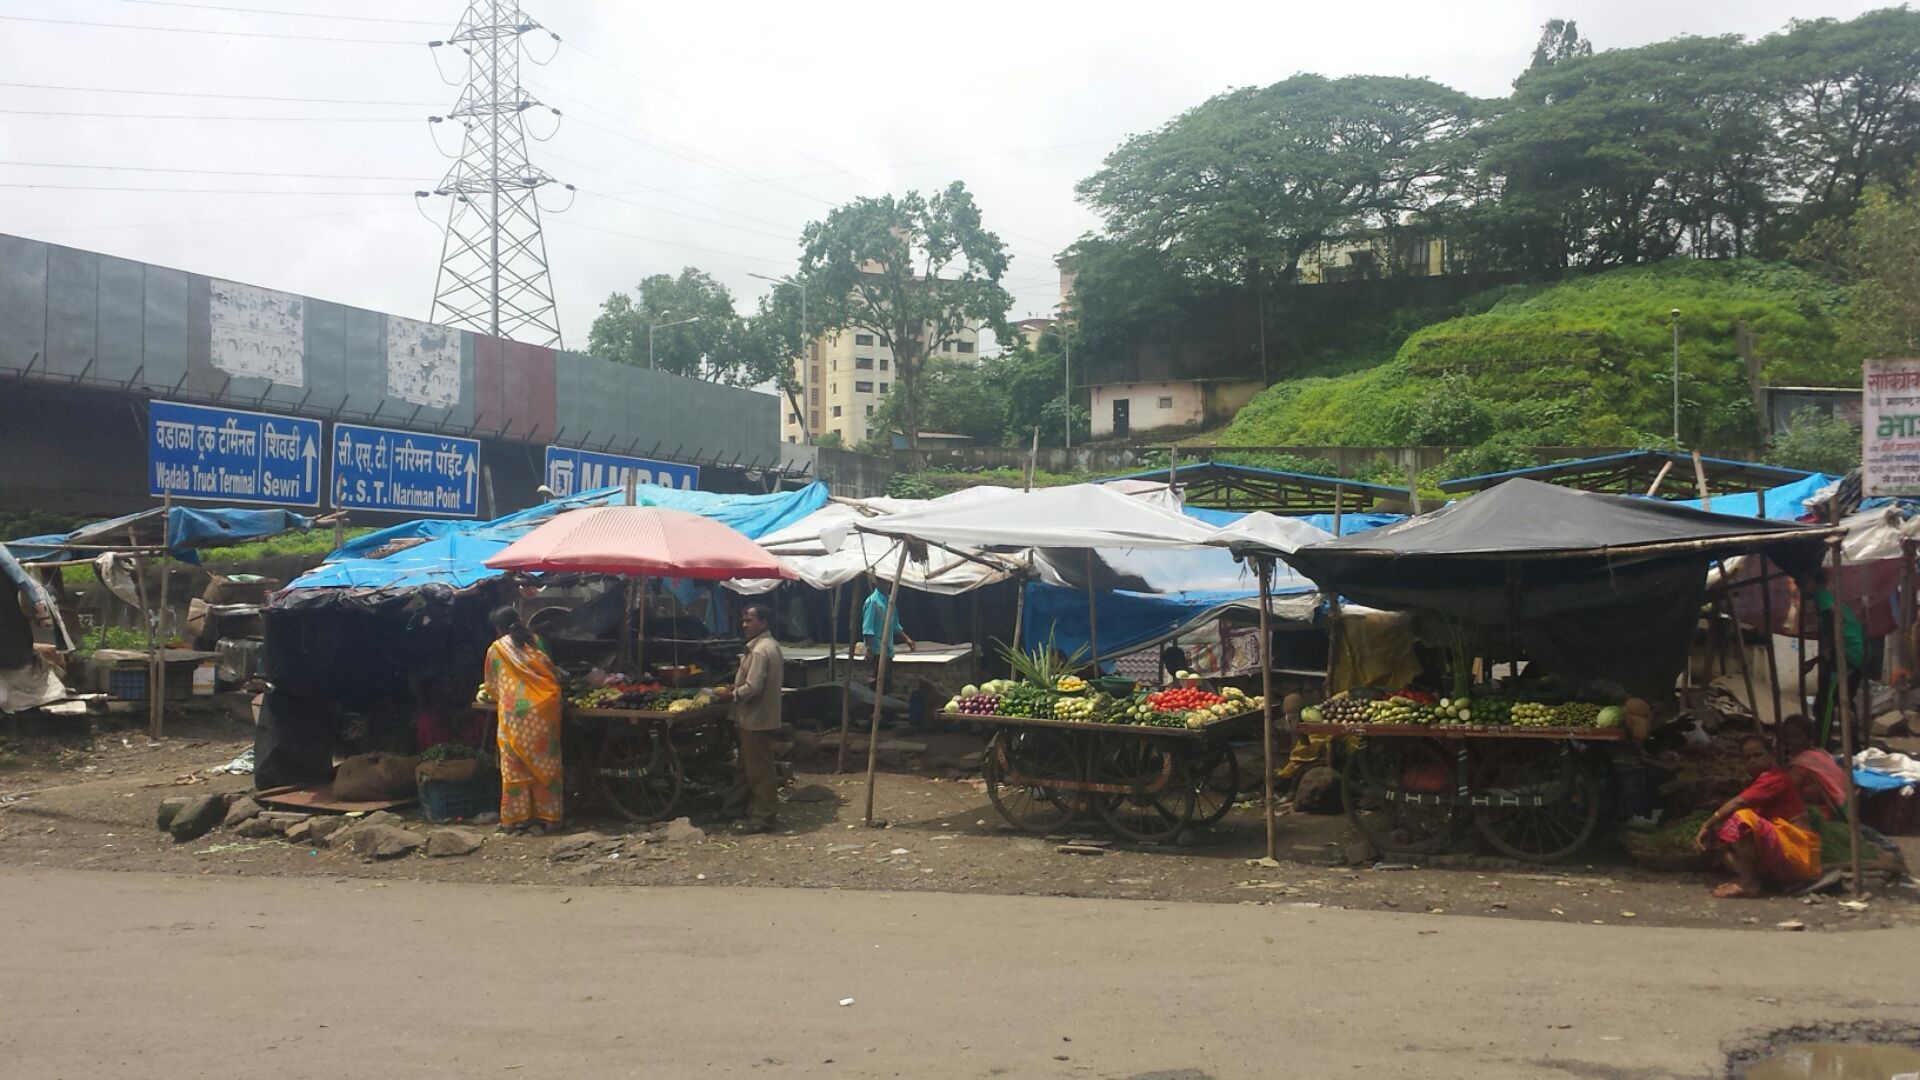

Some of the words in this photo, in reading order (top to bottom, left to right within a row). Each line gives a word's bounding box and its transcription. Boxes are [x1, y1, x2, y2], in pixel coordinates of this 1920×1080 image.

[156, 420, 195, 451] वडाळा
[197, 424, 216, 461] ट्रक
[218, 417, 256, 457] टर्मिनल
[264, 422, 301, 461] शिवडी
[395, 438, 433, 474] नरिमन
[156, 461, 190, 490] Wadala
[192, 464, 217, 493] Truck
[218, 466, 256, 495] Terminal
[263, 471, 301, 498] Sewri
[392, 481, 434, 507] Nariman
[435, 485, 461, 509] Point
